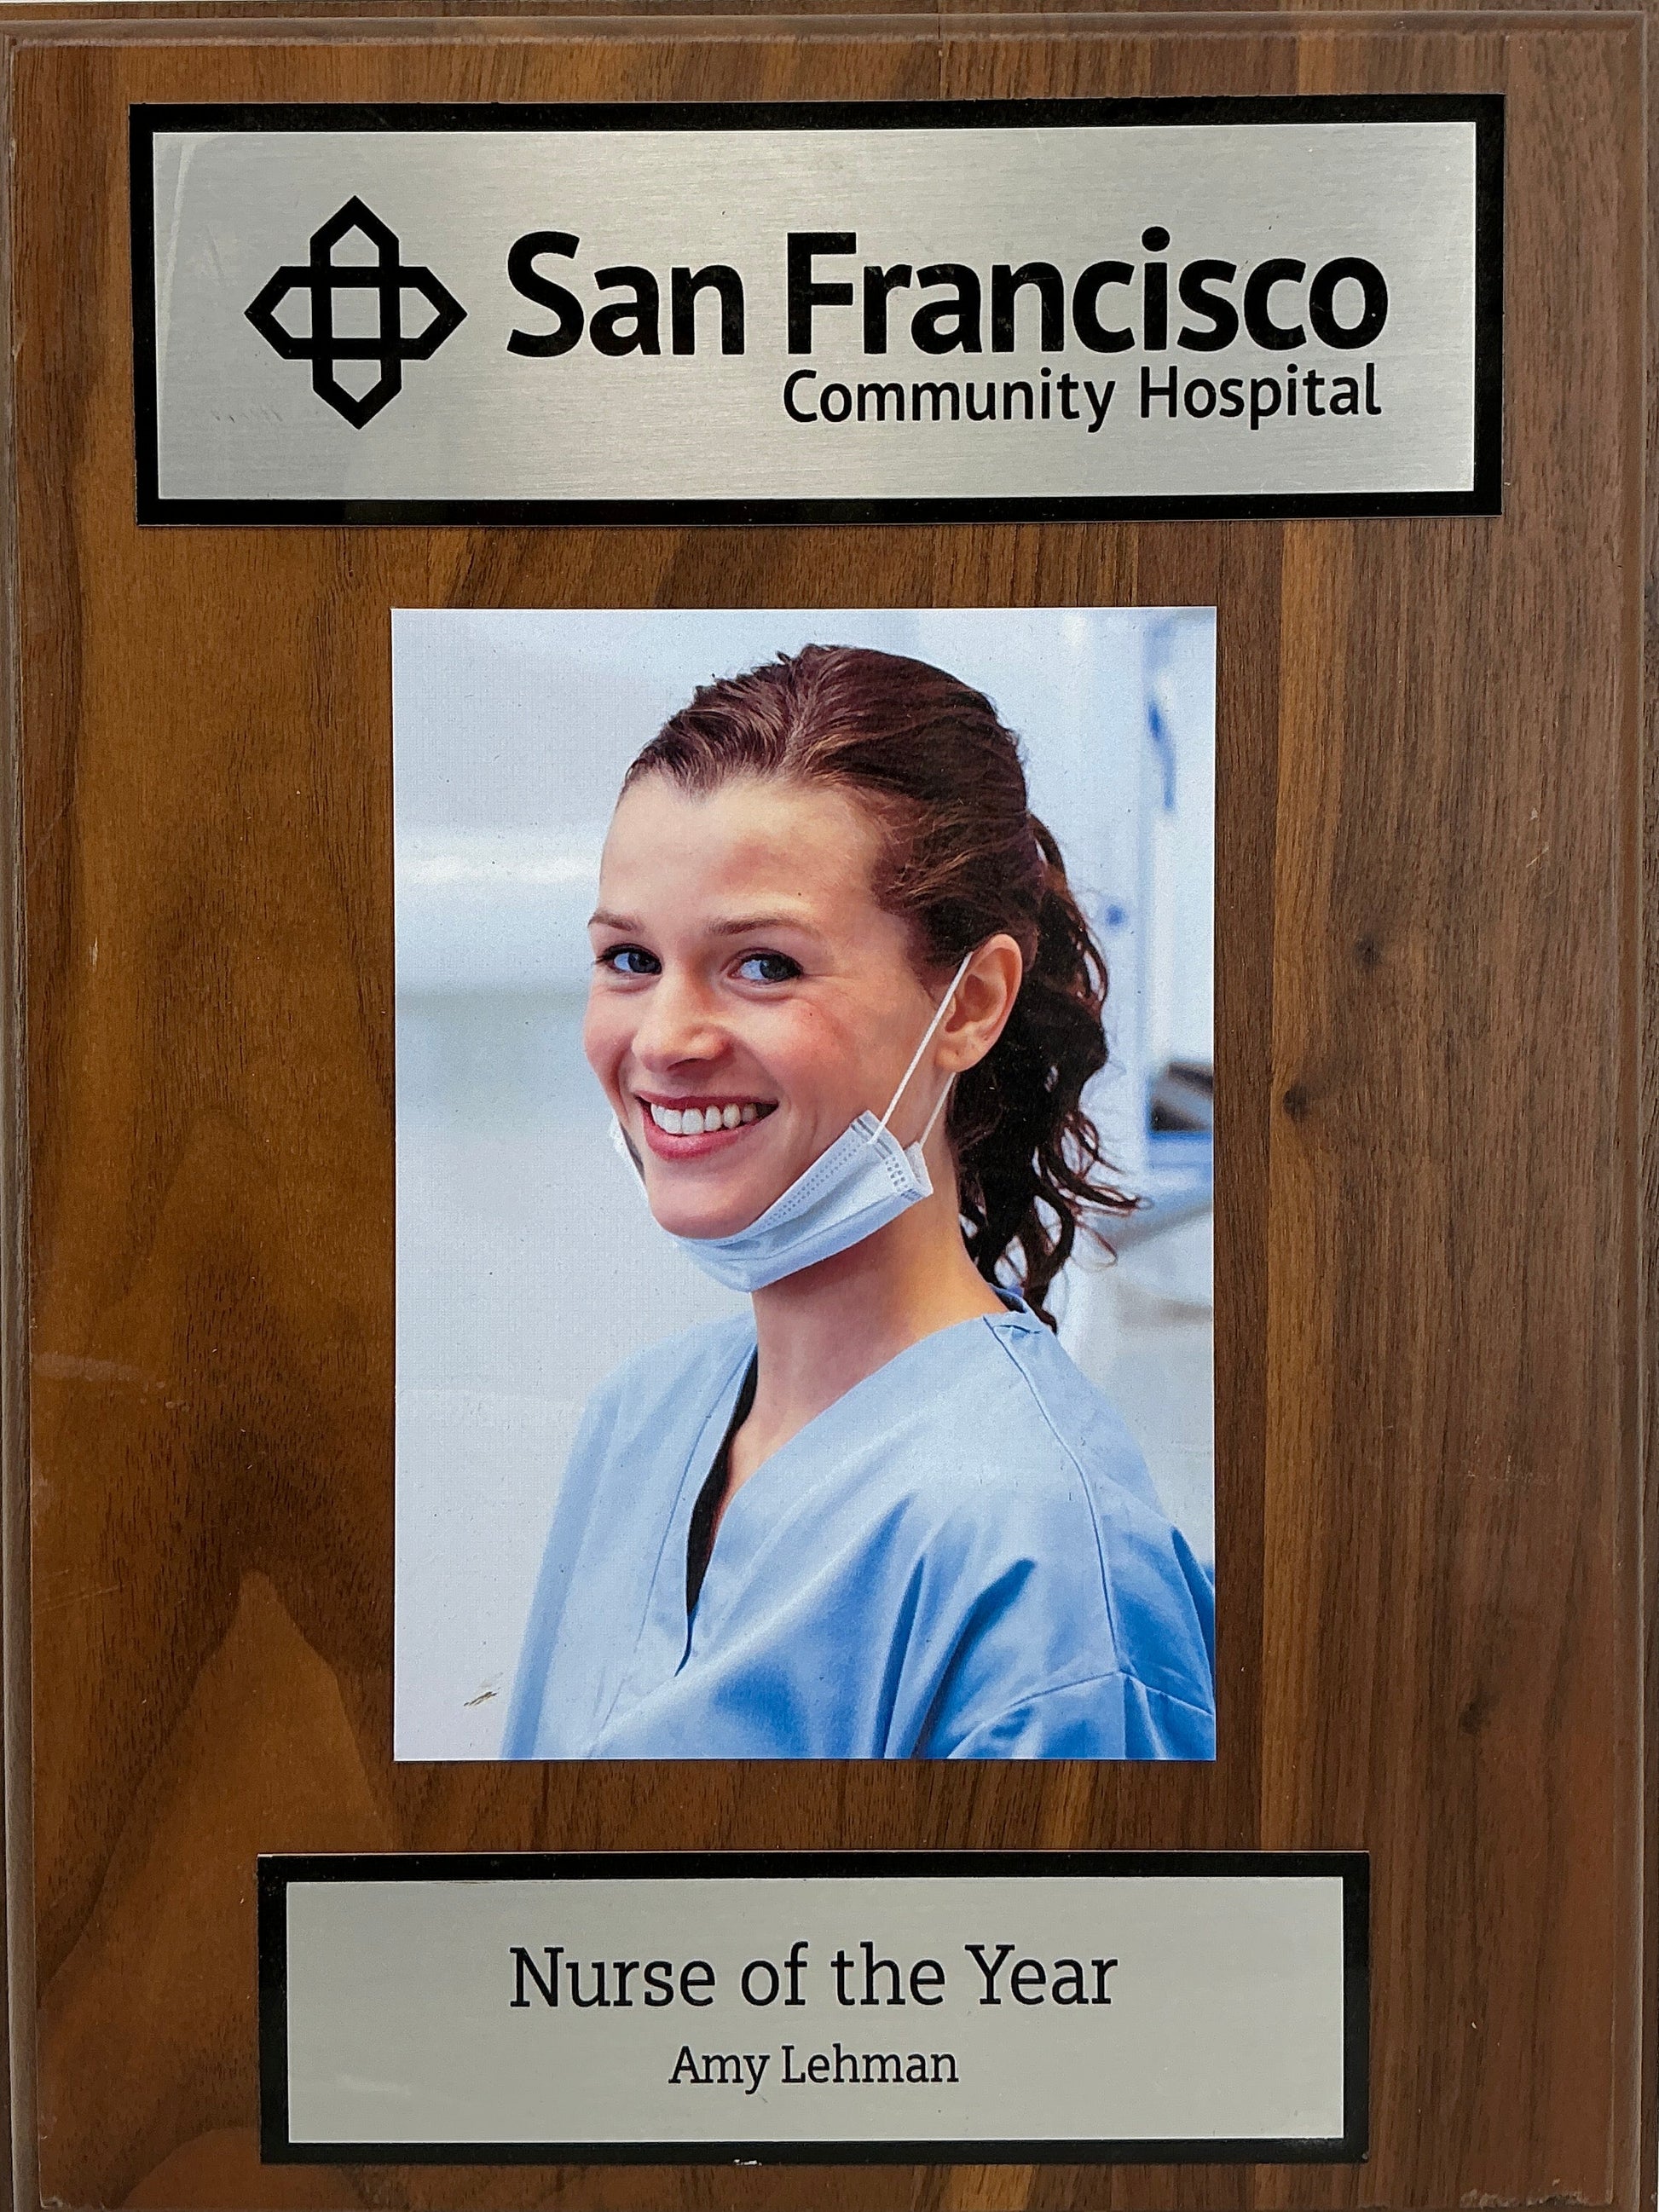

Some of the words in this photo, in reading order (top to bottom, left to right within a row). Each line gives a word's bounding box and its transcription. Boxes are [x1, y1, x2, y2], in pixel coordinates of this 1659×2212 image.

[506, 230, 746, 358] San
[787, 226, 1390, 355] Francisco
[783, 367, 1116, 434] Community
[1141, 362, 1382, 431] Hospital
[509, 1946, 717, 2008] Nurse
[741, 1940, 809, 2007] of
[830, 1941, 945, 2007] the
[964, 1943, 1119, 2006] Year
[668, 2045, 771, 2095] Amy
[781, 2042, 960, 2084] Lehman
